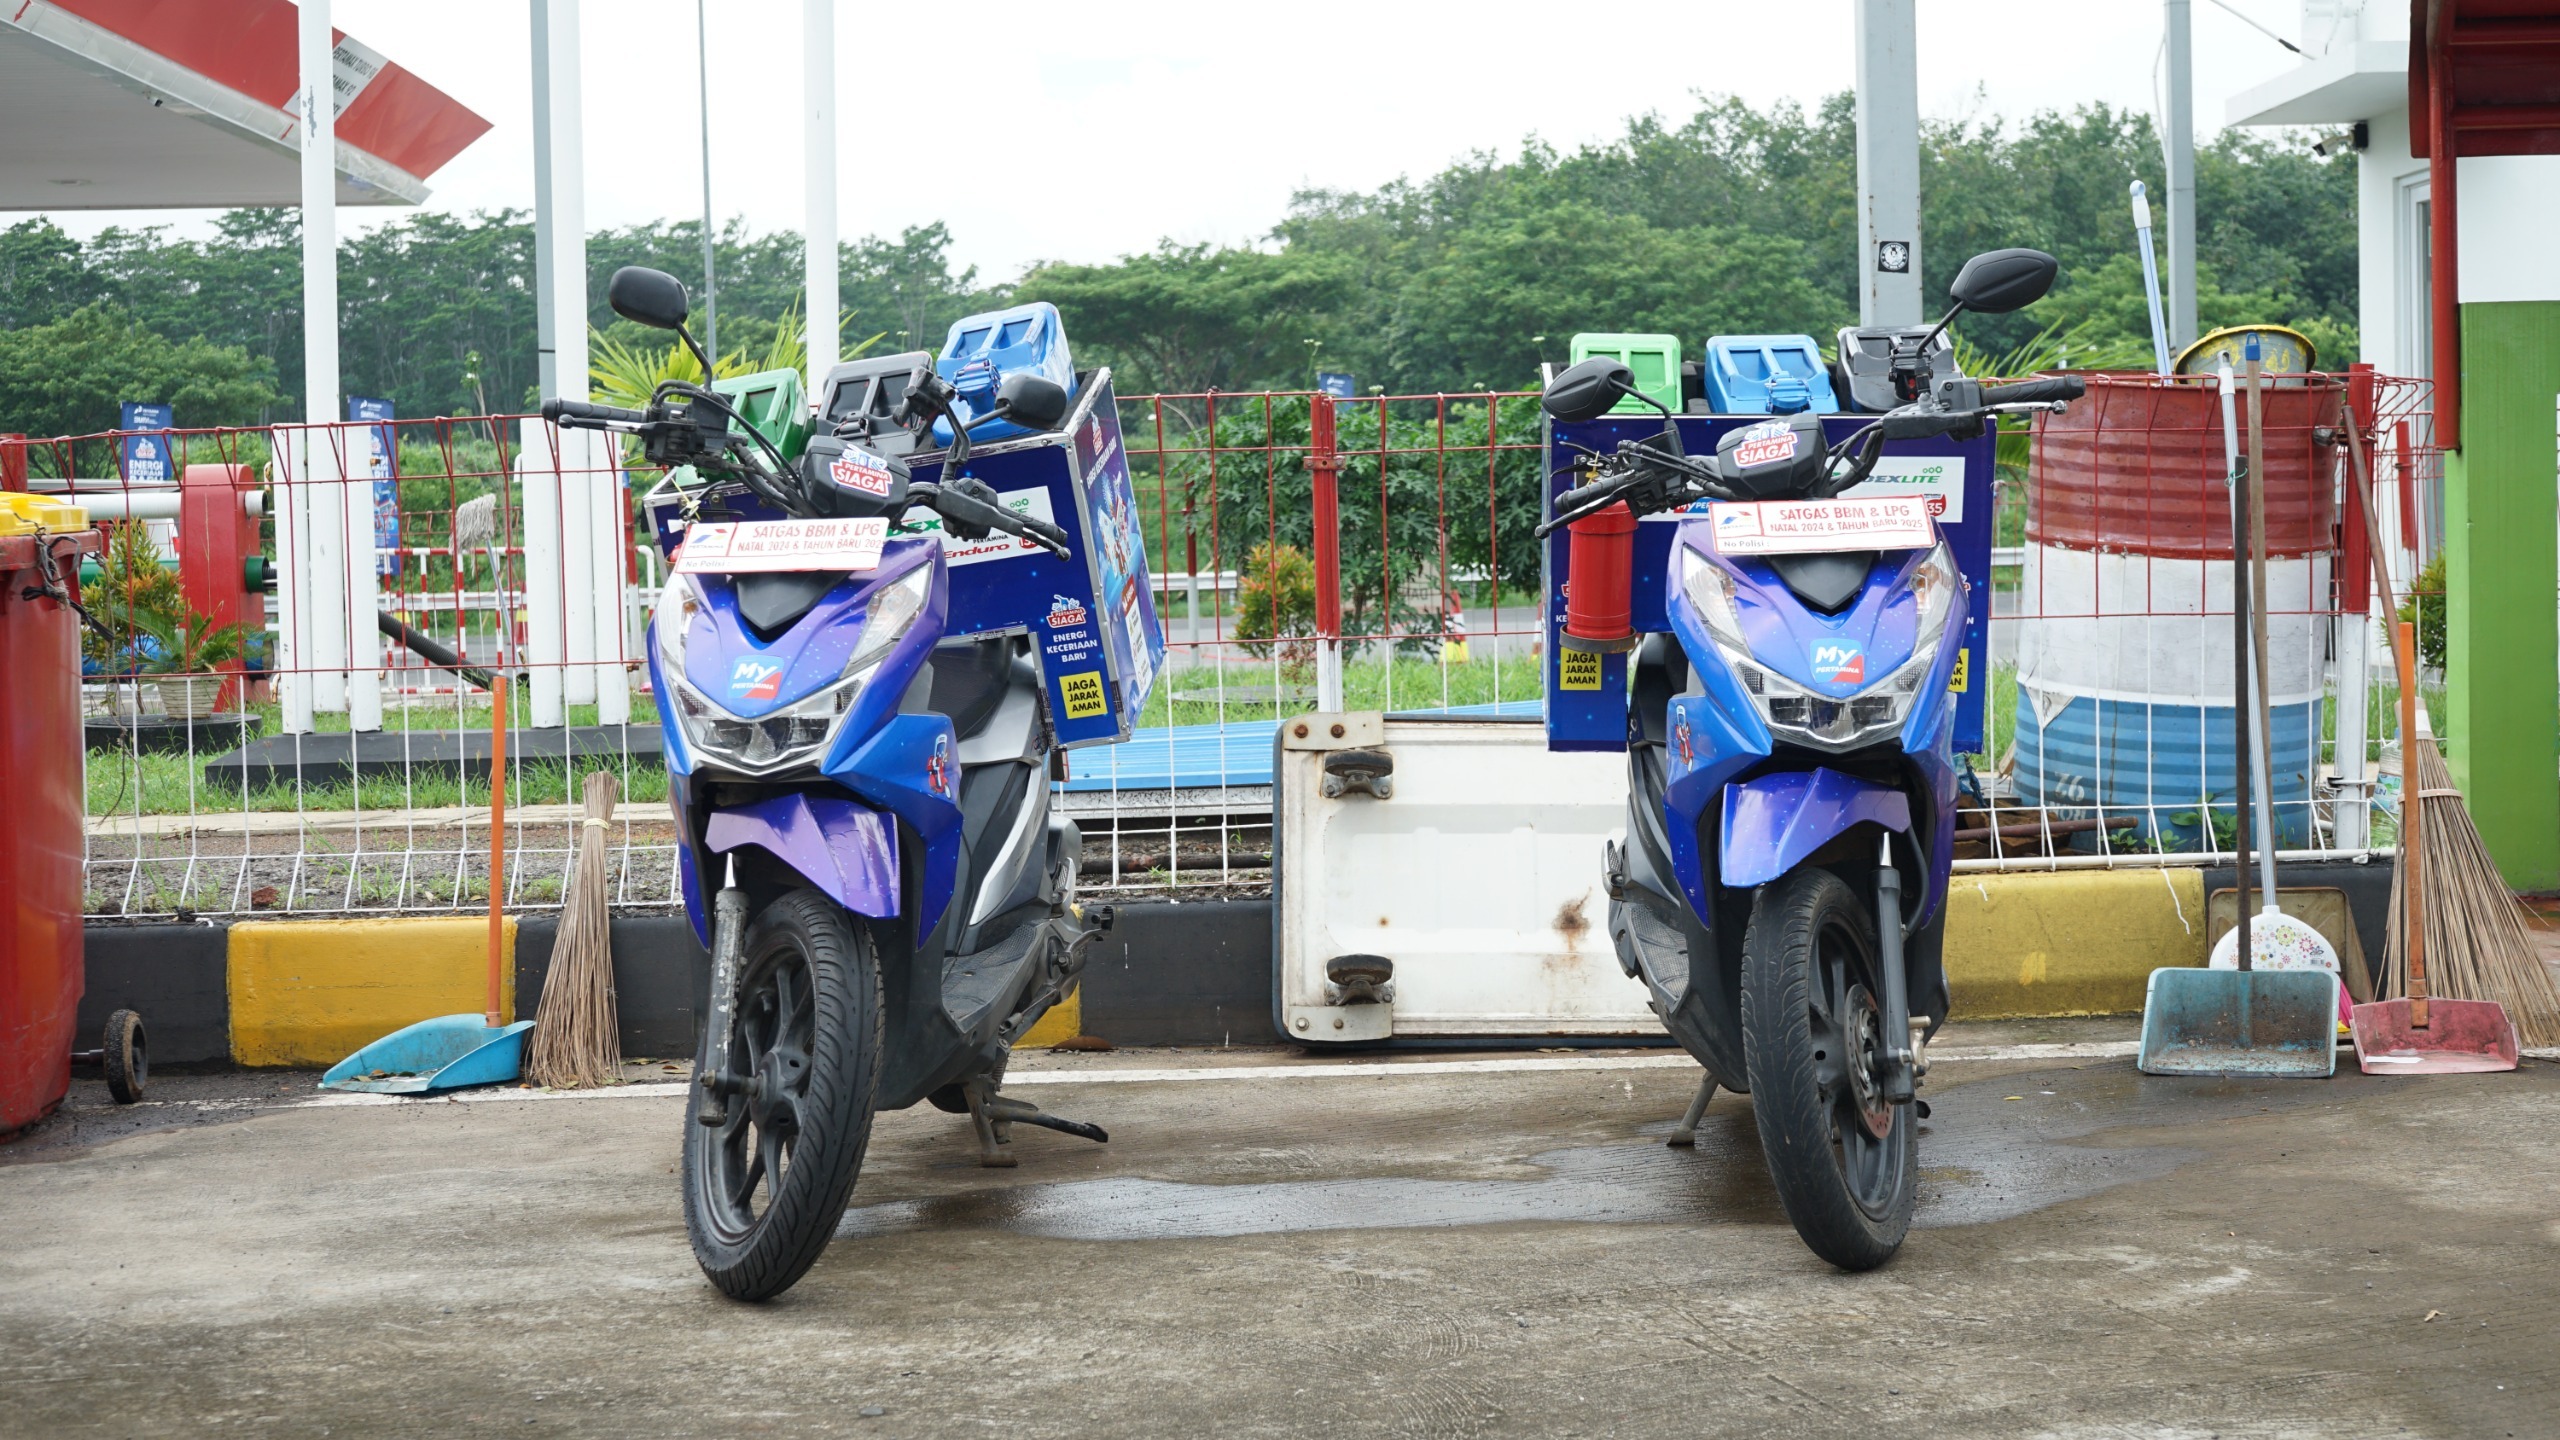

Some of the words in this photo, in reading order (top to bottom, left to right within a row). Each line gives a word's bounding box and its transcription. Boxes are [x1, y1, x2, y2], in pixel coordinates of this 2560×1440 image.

[1748, 435, 1793, 450] PERTAMINA
[1740, 442, 1791, 464] SIAGA
[129, 460, 163, 470] ENERGI
[845, 463, 889, 480] PERTAMINA
[836, 469, 885, 492] SIAGA
[1780, 507, 1829, 520] SATGAS
[1834, 507, 1865, 519] BBM
[1870, 507, 1880, 517] &
[1884, 505, 1910, 517] LPG
[1927, 502, 1943, 514] 35
[753, 525, 800, 539] SATGAS
[805, 524, 837, 538] BBM
[840, 523, 850, 536] &
[854, 523, 881, 537] LPG
[1770, 523, 1798, 532] NATAL
[1801, 523, 1824, 532] 2024
[1827, 522, 1834, 531] &
[1837, 521, 1869, 531] TAHUN
[1873, 519, 1898, 528] BARU
[1901, 519, 1923, 528] 2025
[737, 541, 765, 552] NATAL
[768, 540, 790, 551] 2024
[792, 540, 800, 550] &
[803, 540, 834, 550] TAHUN
[837, 538, 862, 549] BARU
[865, 539, 884, 549] 202
[973, 534, 1009, 544] PERTAMINA
[1739, 540, 1764, 548] Polisi
[943, 543, 1010, 558] Enduro
[700, 560, 726, 568] Polisi
[1055, 608, 1083, 617] PERTAMINA
[1051, 614, 1082, 626] SIAGA
[1053, 630, 1087, 643] ENERGI
[1046, 639, 1098, 654] KECERIAAN
[1061, 652, 1087, 663] BARU
[1566, 653, 1597, 664] JAGA
[1565, 665, 1597, 674] JARAK
[1815, 666, 1860, 674] PERTAMINA
[732, 682, 774, 690] PERTAMINA
[1067, 678, 1097, 692] JAGA
[1566, 676, 1596, 685] AMAN
[1069, 690, 1100, 703] JARAK
[1071, 703, 1101, 713] AMAN
